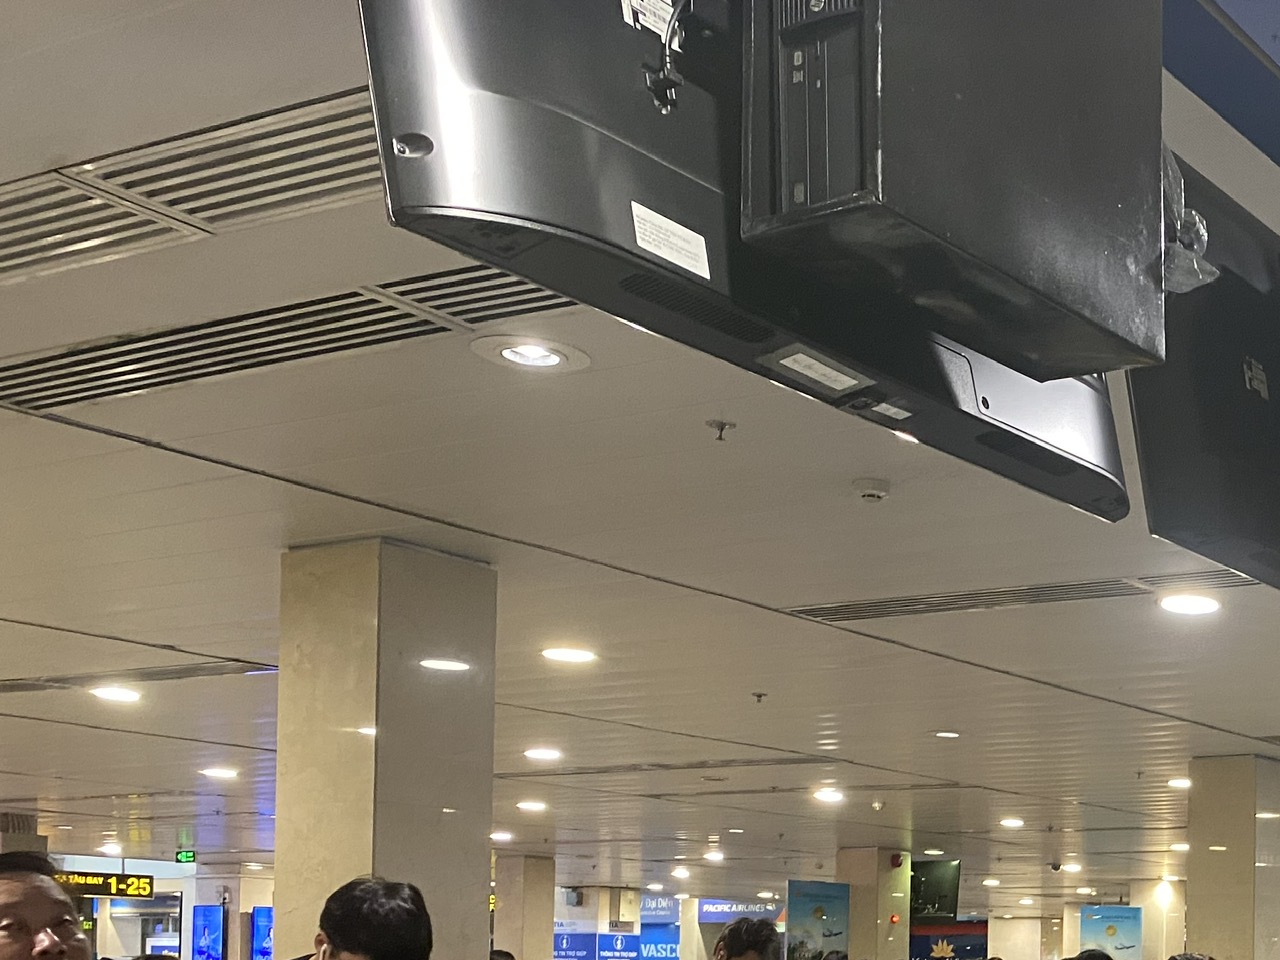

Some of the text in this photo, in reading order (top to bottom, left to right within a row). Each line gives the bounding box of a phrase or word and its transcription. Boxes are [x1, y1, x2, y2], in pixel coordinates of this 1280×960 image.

[107, 876, 151, 895] 1-25
[703, 904, 765, 912] PACIFIC AIRLINES
[641, 943, 680, 957] VASC
